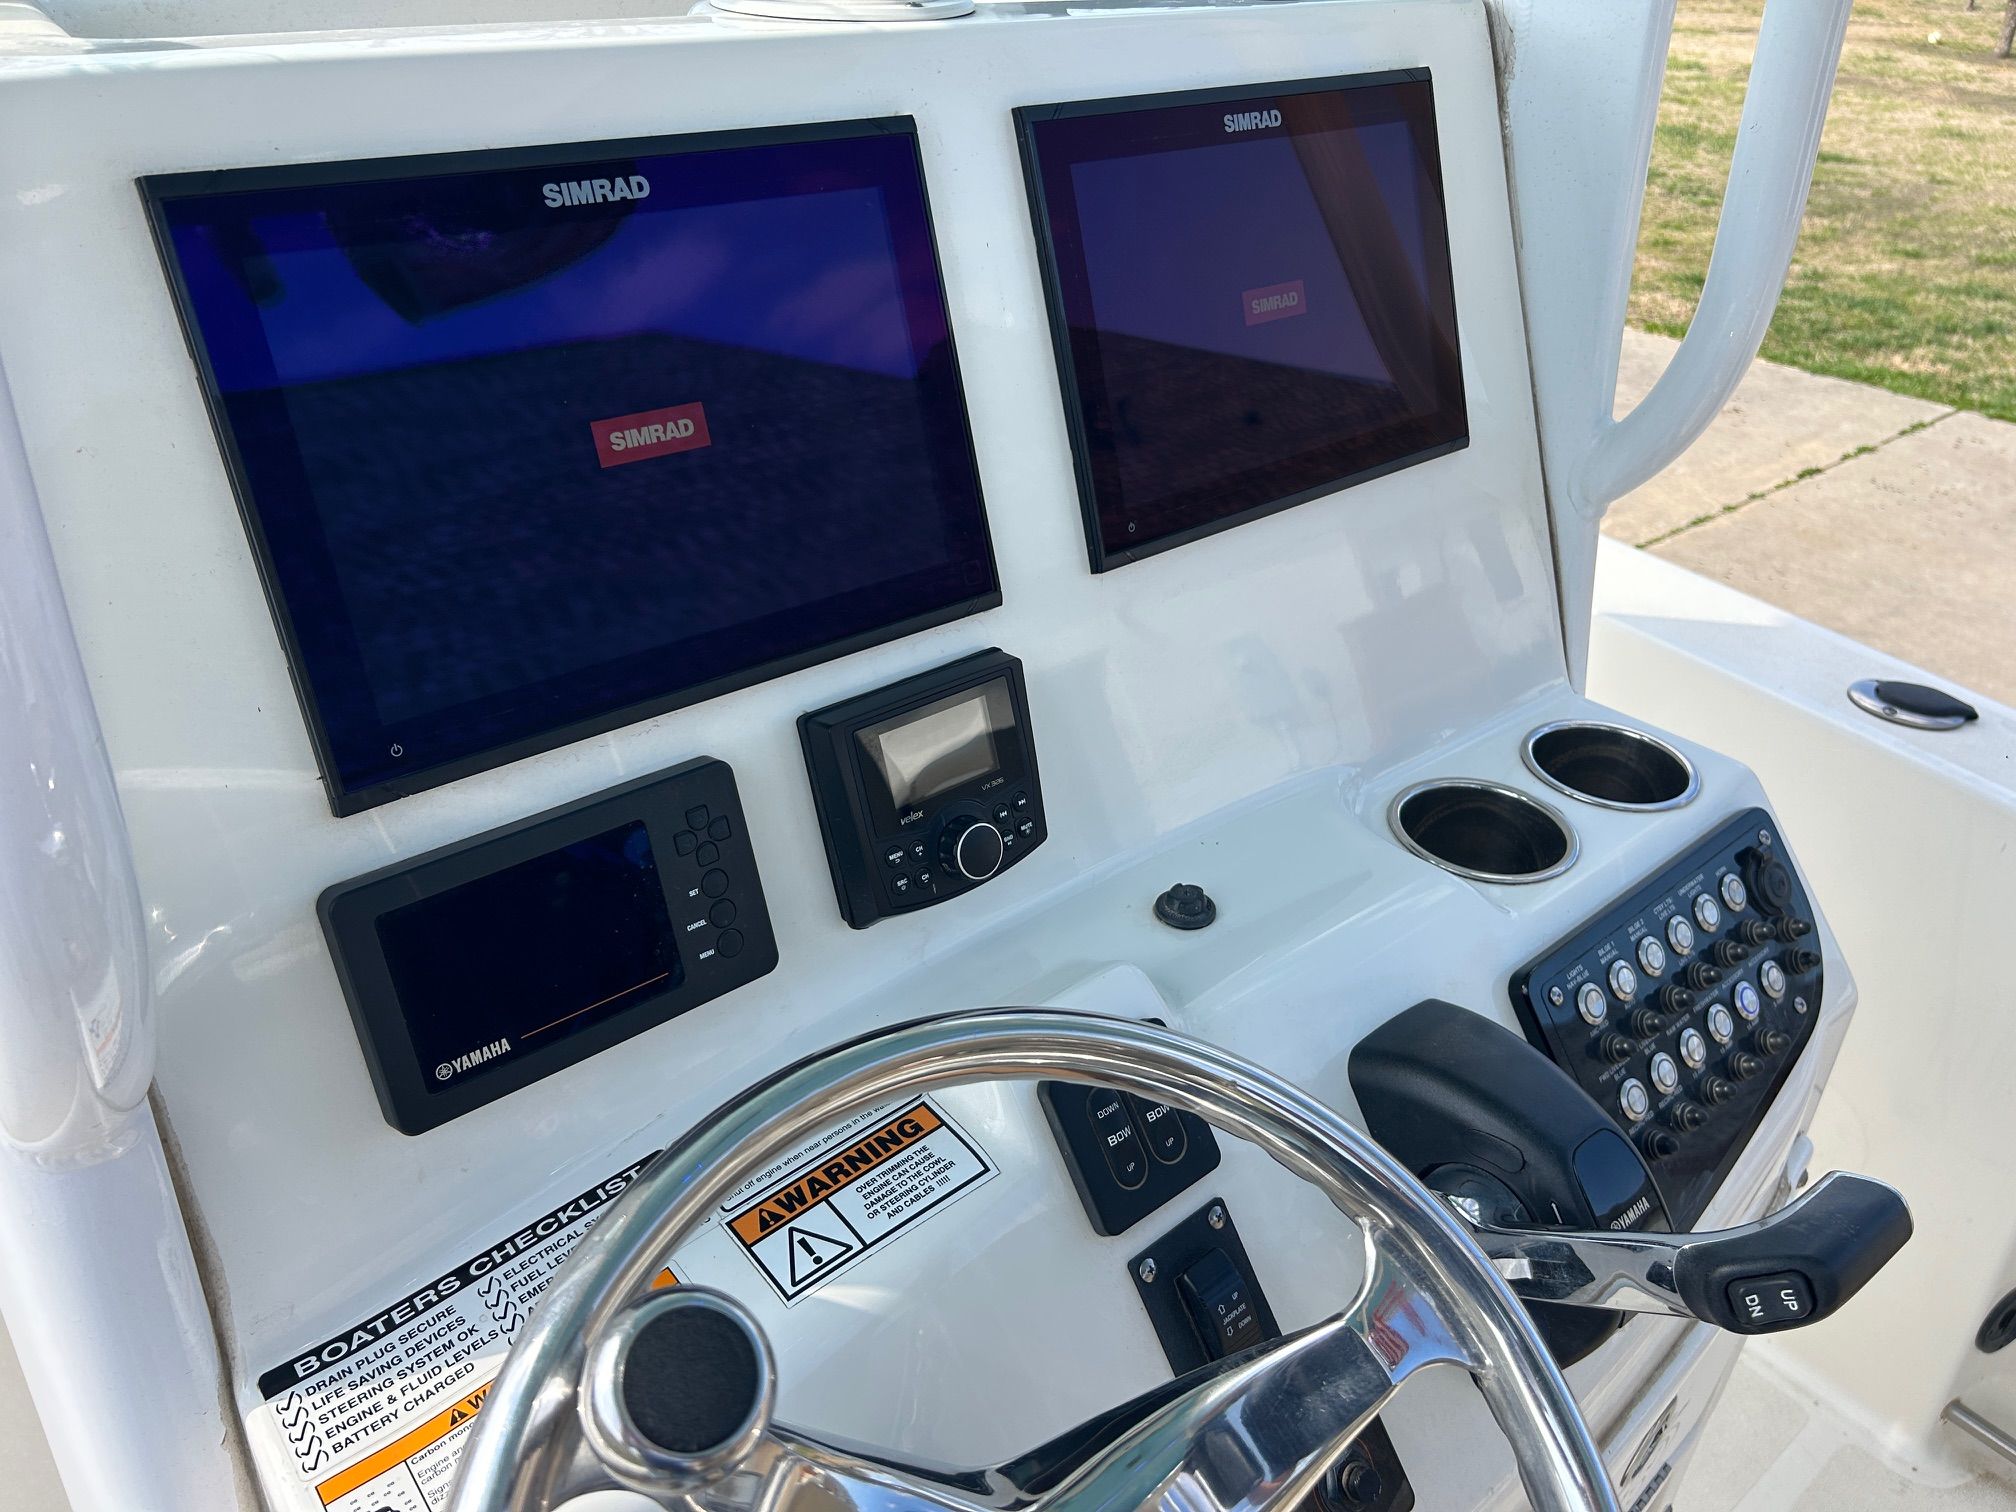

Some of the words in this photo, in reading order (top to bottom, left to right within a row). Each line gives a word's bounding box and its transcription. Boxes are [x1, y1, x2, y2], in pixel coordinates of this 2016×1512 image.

[1224, 109, 1282, 133] SIMRAD
[542, 175, 651, 208] SIMRAD
[1252, 292, 1298, 315] SIMRAD
[609, 418, 695, 451] SIMRAD
[900, 810, 924, 826] velex
[1020, 822, 1033, 831] MUTE
[889, 850, 904, 861] MENU
[688, 888, 699, 898] SET
[897, 877, 908, 887] SRC
[686, 918, 708, 932] CANCEL
[699, 948, 715, 960] MENU
[1566, 963, 1584, 980] LIGHTS
[451, 1037, 511, 1073] YAMAHA
[1097, 1101, 1120, 1120] DOWN
[1145, 1104, 1170, 1123] BOW
[1107, 1125, 1132, 1147] BOW
[1165, 1136, 1175, 1147] UP
[744, 1178, 756, 1190] off
[756, 1164, 782, 1183] engine
[782, 1152, 804, 1167] when
[804, 1141, 821, 1154] near
[822, 1124, 852, 1144] persons
[852, 1118, 860, 1126] in
[860, 1110, 873, 1120] the
[772, 1118, 925, 1214] WARNING
[855, 1177, 879, 1193] OVER
[876, 1154, 915, 1181] TRIMMING
[912, 1144, 930, 1157] THE
[862, 1179, 893, 1200] ENGINE
[891, 1168, 910, 1181] CAN
[908, 1151, 936, 1170] CAUSE
[1126, 1161, 1136, 1172] UP
[863, 1186, 898, 1211] DAMAGE
[896, 1179, 908, 1190] TO
[906, 1169, 924, 1182] THE
[922, 1156, 947, 1172] COWL
[867, 1208, 881, 1220] OR
[879, 1184, 919, 1212] STEERING
[918, 1160, 956, 1187] CYLINDER
[886, 1206, 904, 1220] AND
[903, 1185, 935, 1208] CABLES
[1618, 1196, 1651, 1230] YAMAHA
[502, 1229, 584, 1281] ELECTRICAL
[293, 1276, 461, 1378] BOATERS
[469, 1165, 641, 1277] CHECKLIST
[510, 1268, 546, 1292] FUEL
[1231, 1291, 1239, 1300] UP
[1745, 1294, 1764, 1318] DN
[1780, 1289, 1799, 1311] UP
[1223, 1302, 1247, 1326] JACKPLATE
[1238, 1315, 1252, 1329] DOWN
[305, 1366, 353, 1397] DRAIN
[355, 1342, 397, 1370] PLUG
[399, 1304, 457, 1345] SECURE
[311, 1386, 346, 1411] LIFE
[347, 1355, 402, 1391] SAVING
[404, 1315, 467, 1358] DEVICES
[318, 1377, 395, 1425] STEERING
[398, 1339, 456, 1380] SYSTEM
[457, 1324, 480, 1342] OK
[325, 1400, 384, 1439] ENGINE
[387, 1394, 398, 1405] &
[400, 1365, 443, 1397] FLUID
[444, 1329, 499, 1368] LEVELS
[332, 1408, 400, 1454] BATTERY
[403, 1362, 475, 1412] CHARGED
[411, 1440, 447, 1465] Carbon
[417, 1455, 450, 1479] Engine
[421, 1462, 453, 1485] carbon
